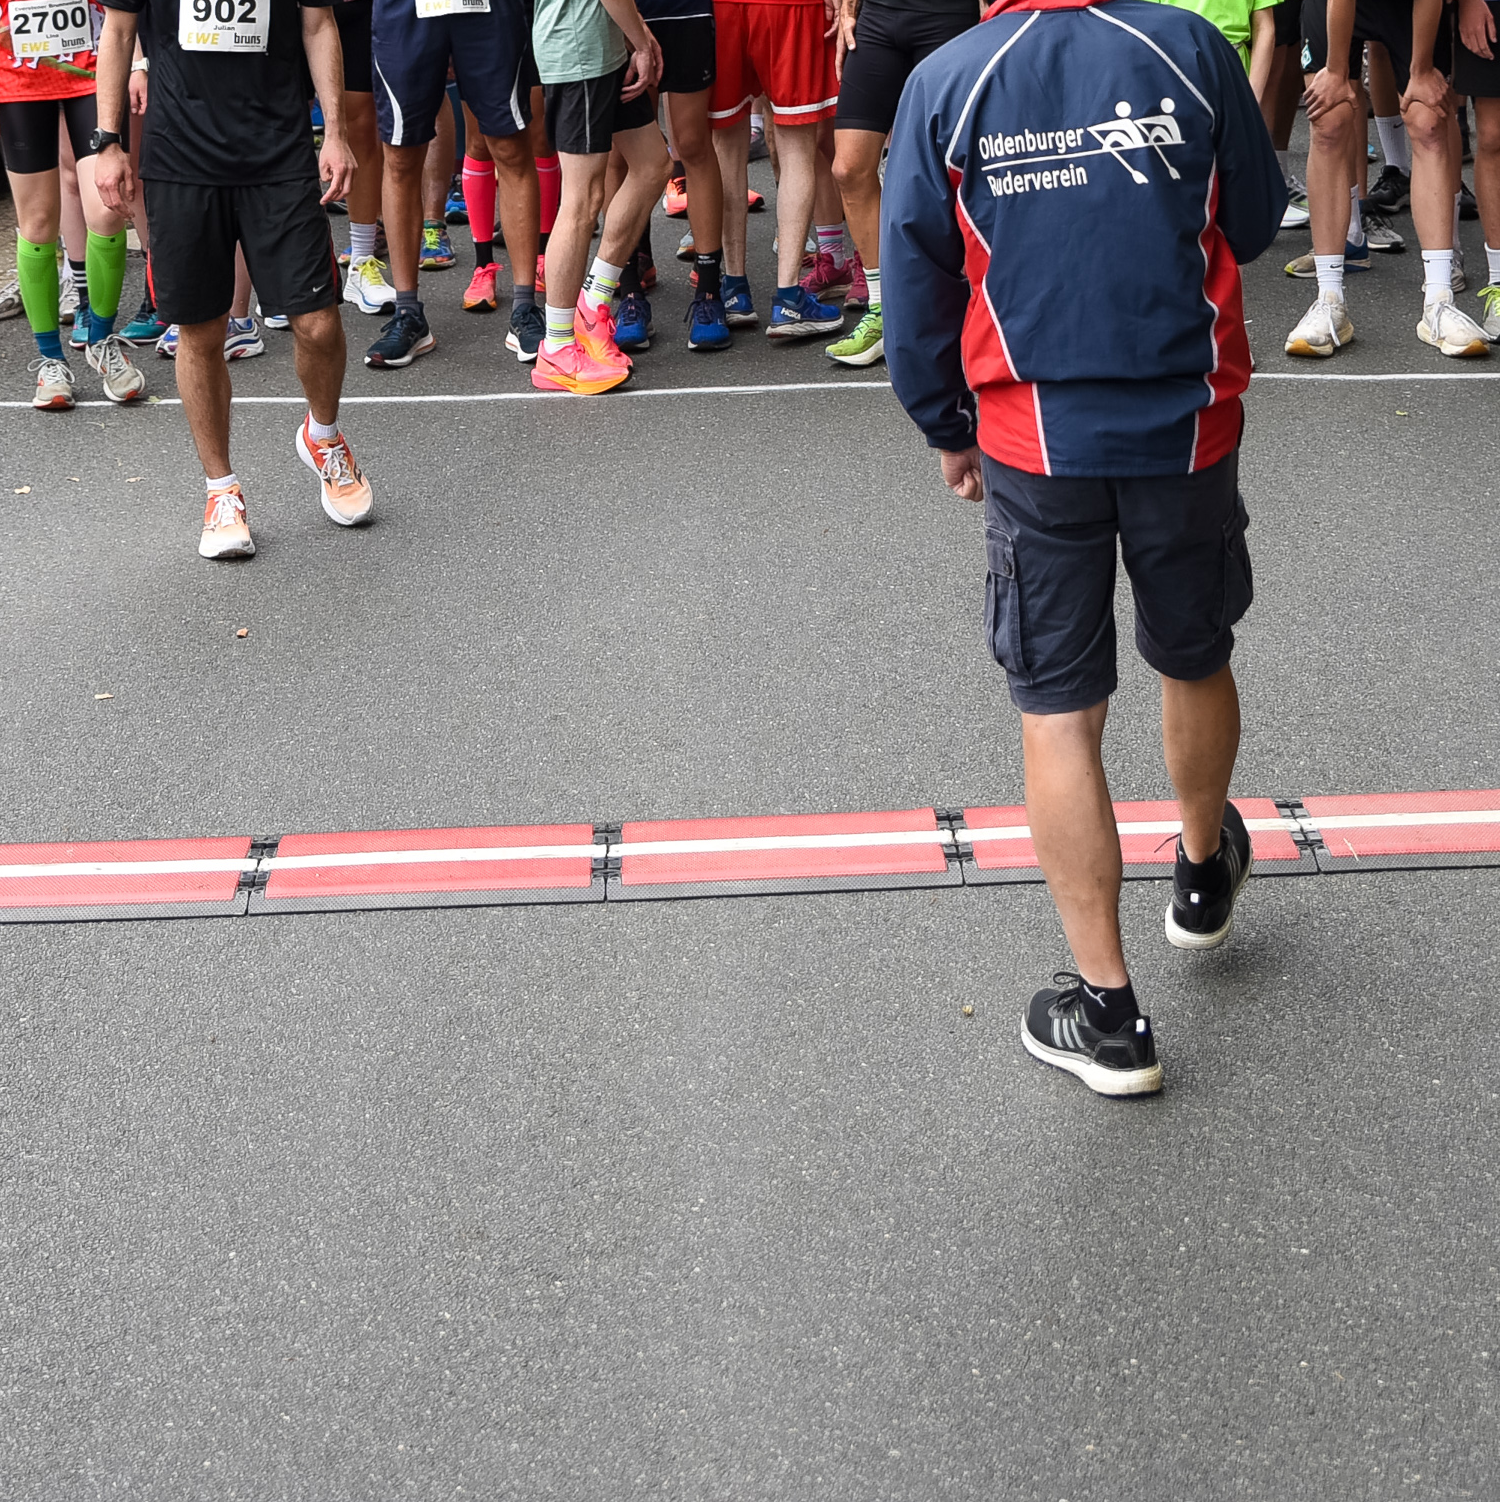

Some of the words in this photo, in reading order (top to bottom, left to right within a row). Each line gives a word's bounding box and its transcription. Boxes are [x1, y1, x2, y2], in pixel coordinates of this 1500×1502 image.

[425, 0, 451, 12] EWE
[12, 6, 87, 35] 2700
[61, 36, 86, 48] bruns
[186, 32, 220, 45] EWE
[233, 32, 262, 45] bruns
[21, 40, 50, 53] EWE
[978, 125, 1085, 162] Oldenburger
[986, 165, 1088, 198] Ruderverein
